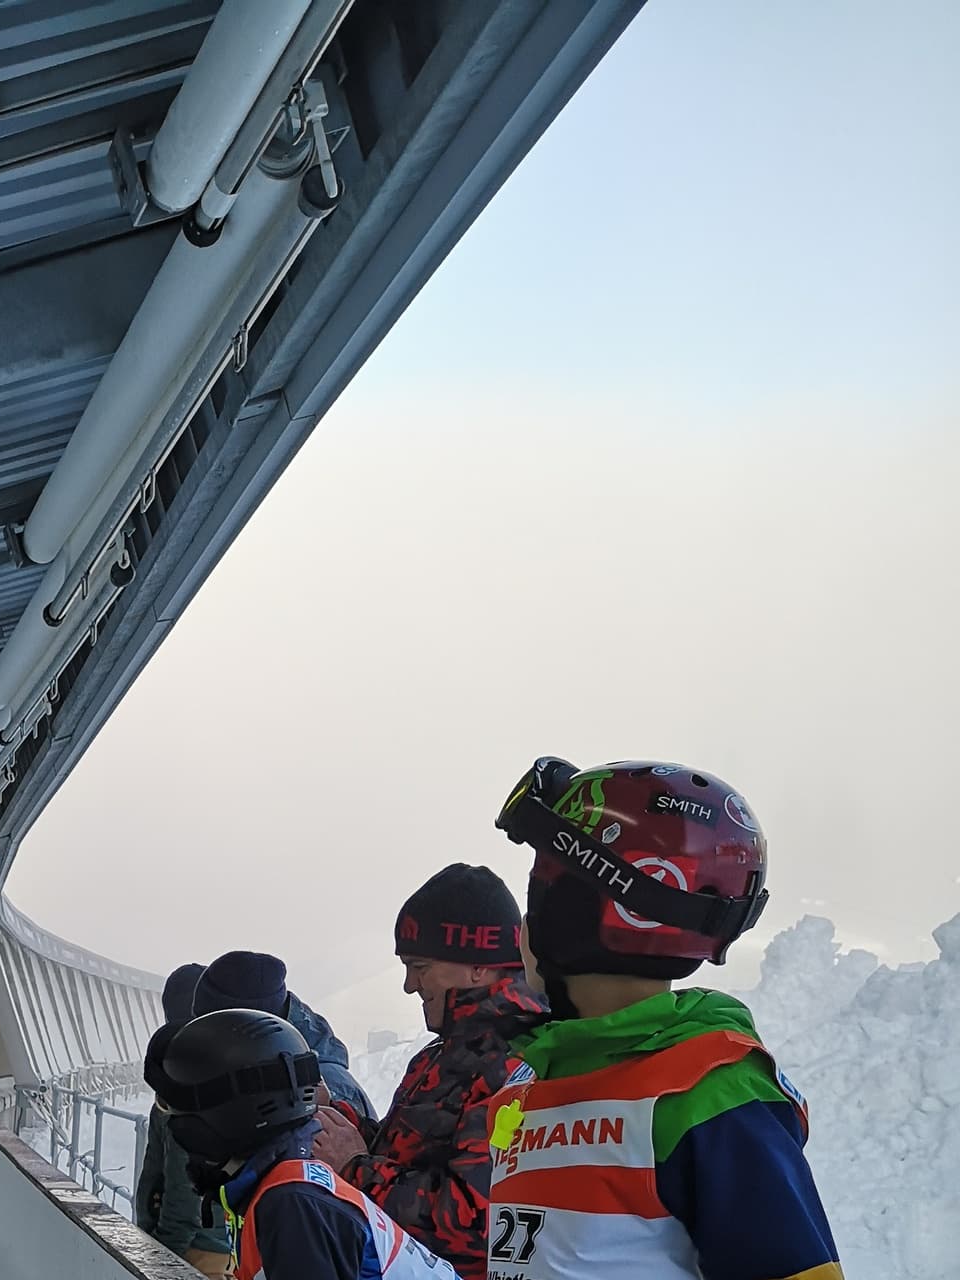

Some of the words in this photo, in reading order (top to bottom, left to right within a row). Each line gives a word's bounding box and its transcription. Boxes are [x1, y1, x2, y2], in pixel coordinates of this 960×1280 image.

[656, 796, 712, 820] SMITH
[552, 831, 634, 895] SMITH
[440, 922, 502, 950] THE
[489, 1207, 546, 1265] 27
